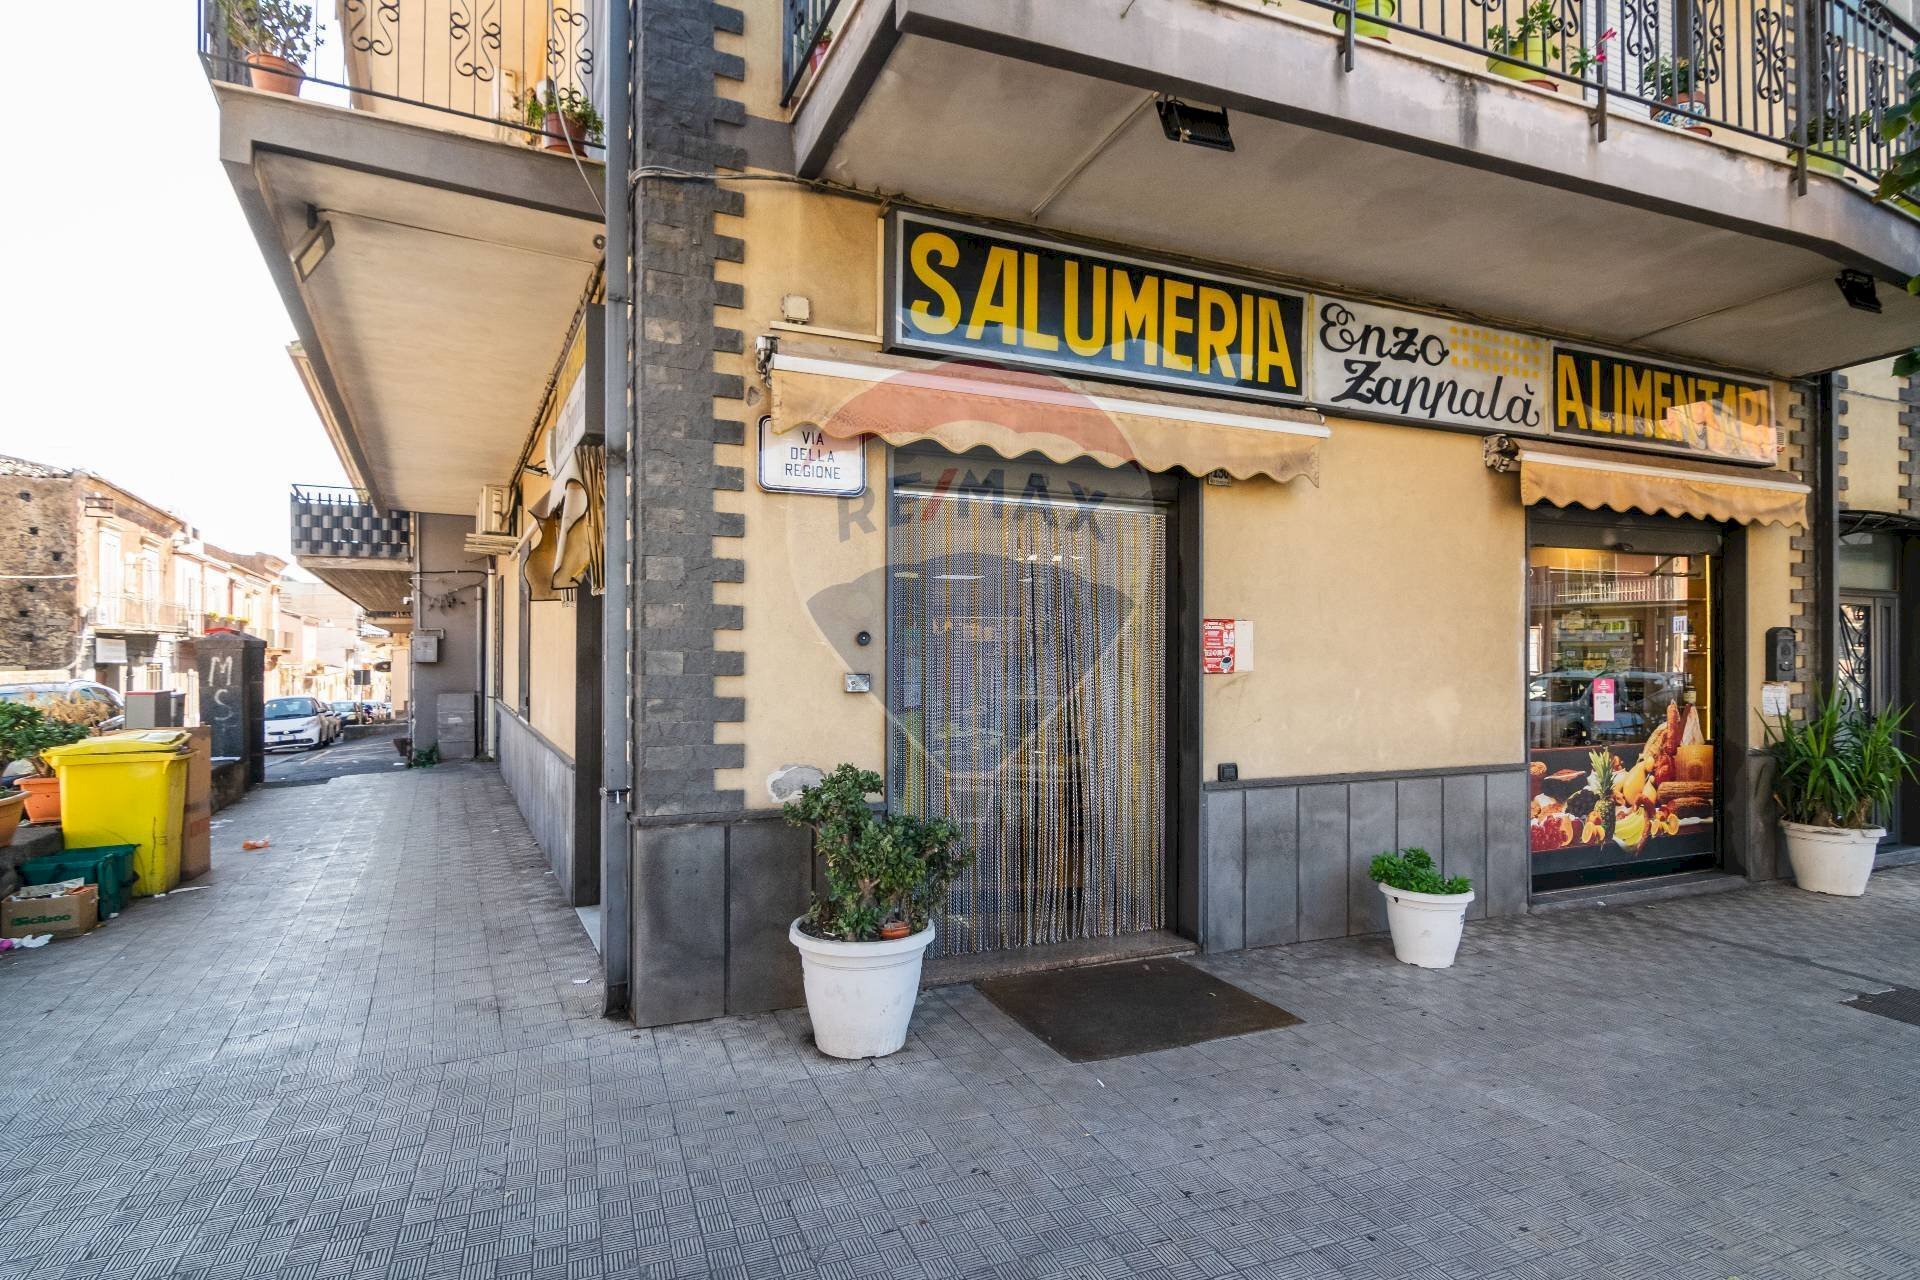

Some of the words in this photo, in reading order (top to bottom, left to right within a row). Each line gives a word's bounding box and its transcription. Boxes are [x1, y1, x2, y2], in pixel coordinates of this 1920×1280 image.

[910, 231, 1297, 388] SALUMERIA
[1319, 301, 1451, 367] Enzo
[1331, 358, 1541, 427] Zappalà
[1556, 353, 1770, 452] ALIMENTARI
[785, 463, 841, 480] REGIONE
[790, 446, 835, 463] DELLA
[802, 431, 824, 446] VIA
